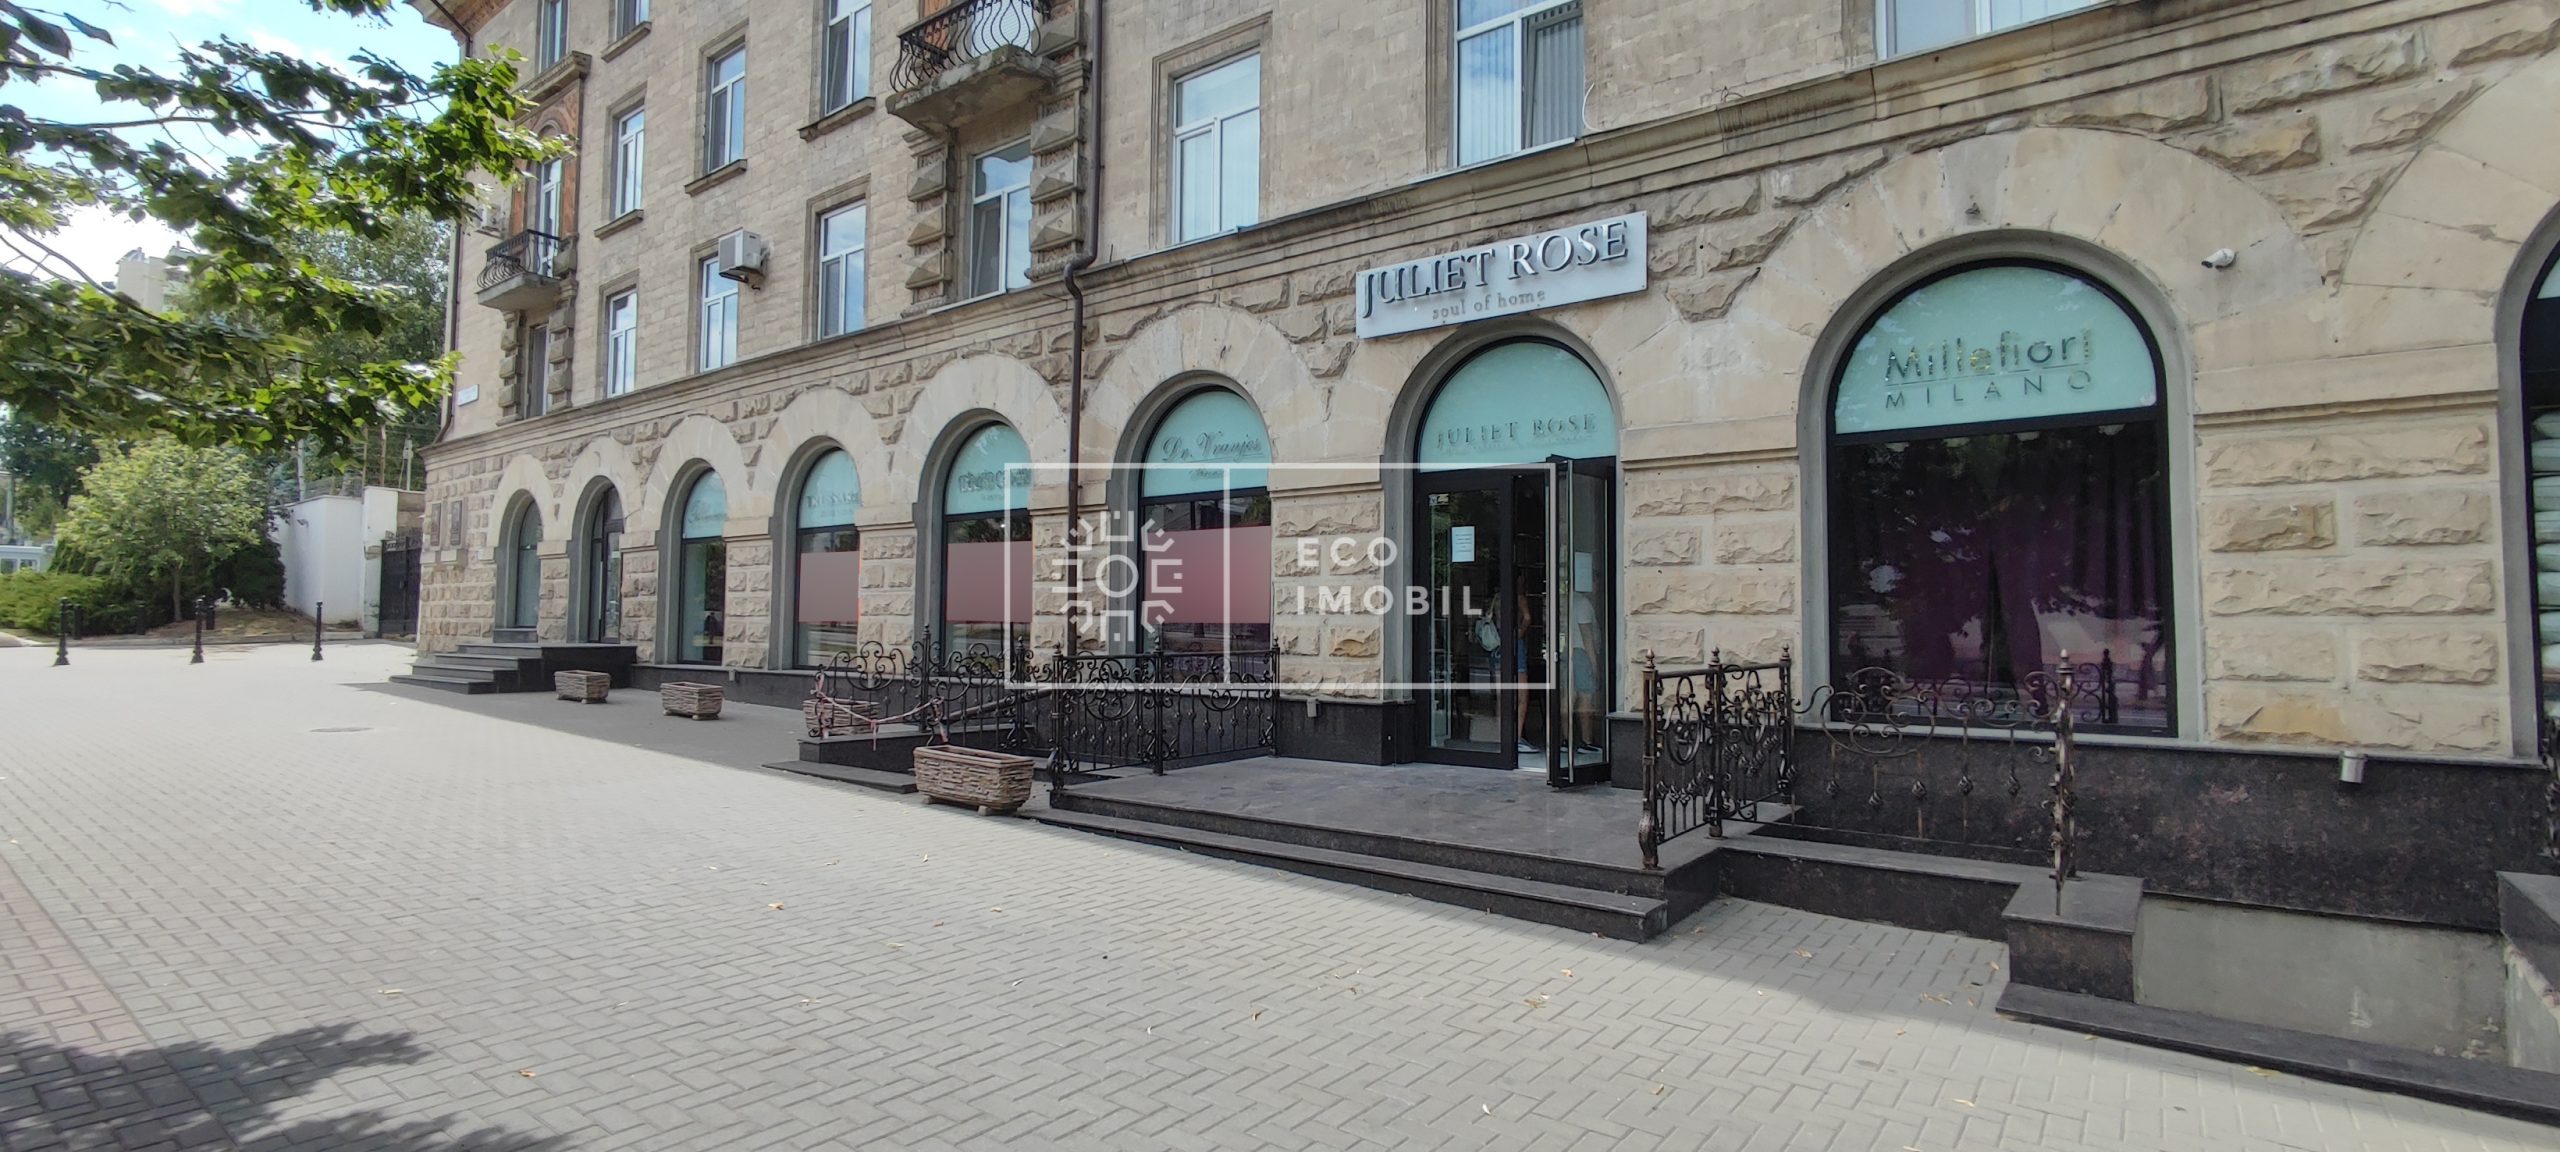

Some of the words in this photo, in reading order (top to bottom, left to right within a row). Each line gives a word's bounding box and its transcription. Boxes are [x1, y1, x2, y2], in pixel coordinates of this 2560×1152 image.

[1362, 247, 1496, 319] JULIET
[1507, 220, 1629, 280] ROSE
[1432, 299, 1467, 321] soul
[1474, 293, 1491, 313] of
[1497, 288, 1547, 309] home
[1885, 370, 2092, 409] MILANO
[1437, 421, 1519, 449] JULIET
[1533, 412, 1598, 436] ROSE
